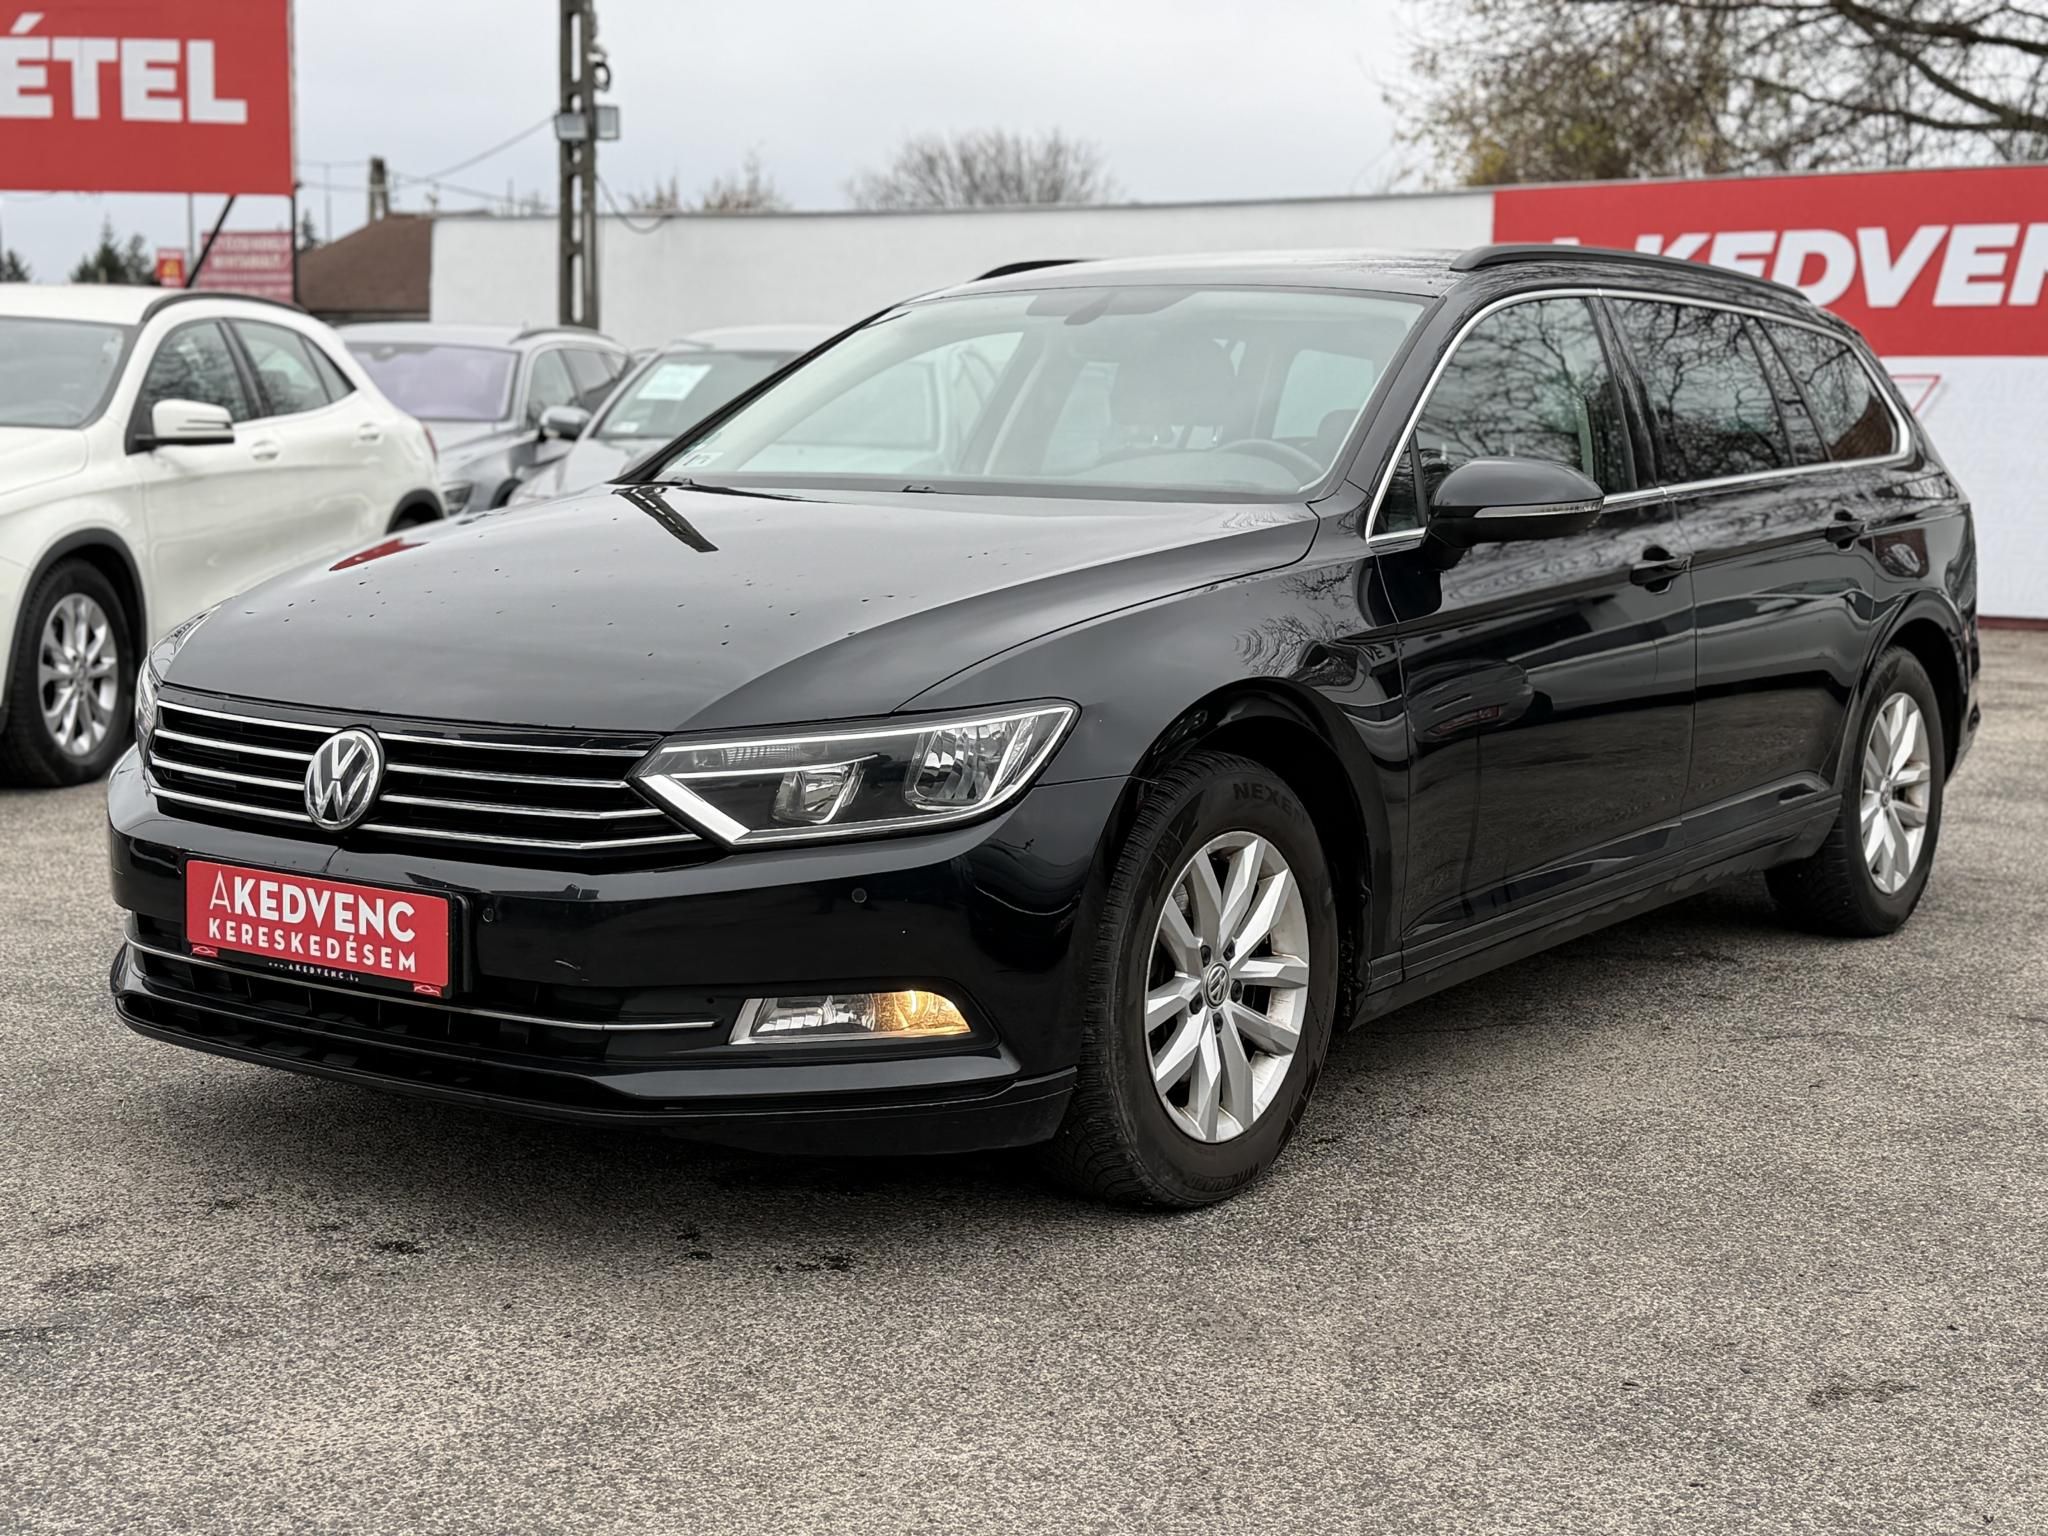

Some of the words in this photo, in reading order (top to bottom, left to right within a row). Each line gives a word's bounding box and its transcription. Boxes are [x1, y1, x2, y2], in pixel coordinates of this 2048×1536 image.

[0, 12, 248, 124] ÉTEL
[1635, 222, 2048, 309] EDVE
[208, 917, 416, 973] KERESKEDÉSEM
[209, 870, 416, 943] AKEDVENC
